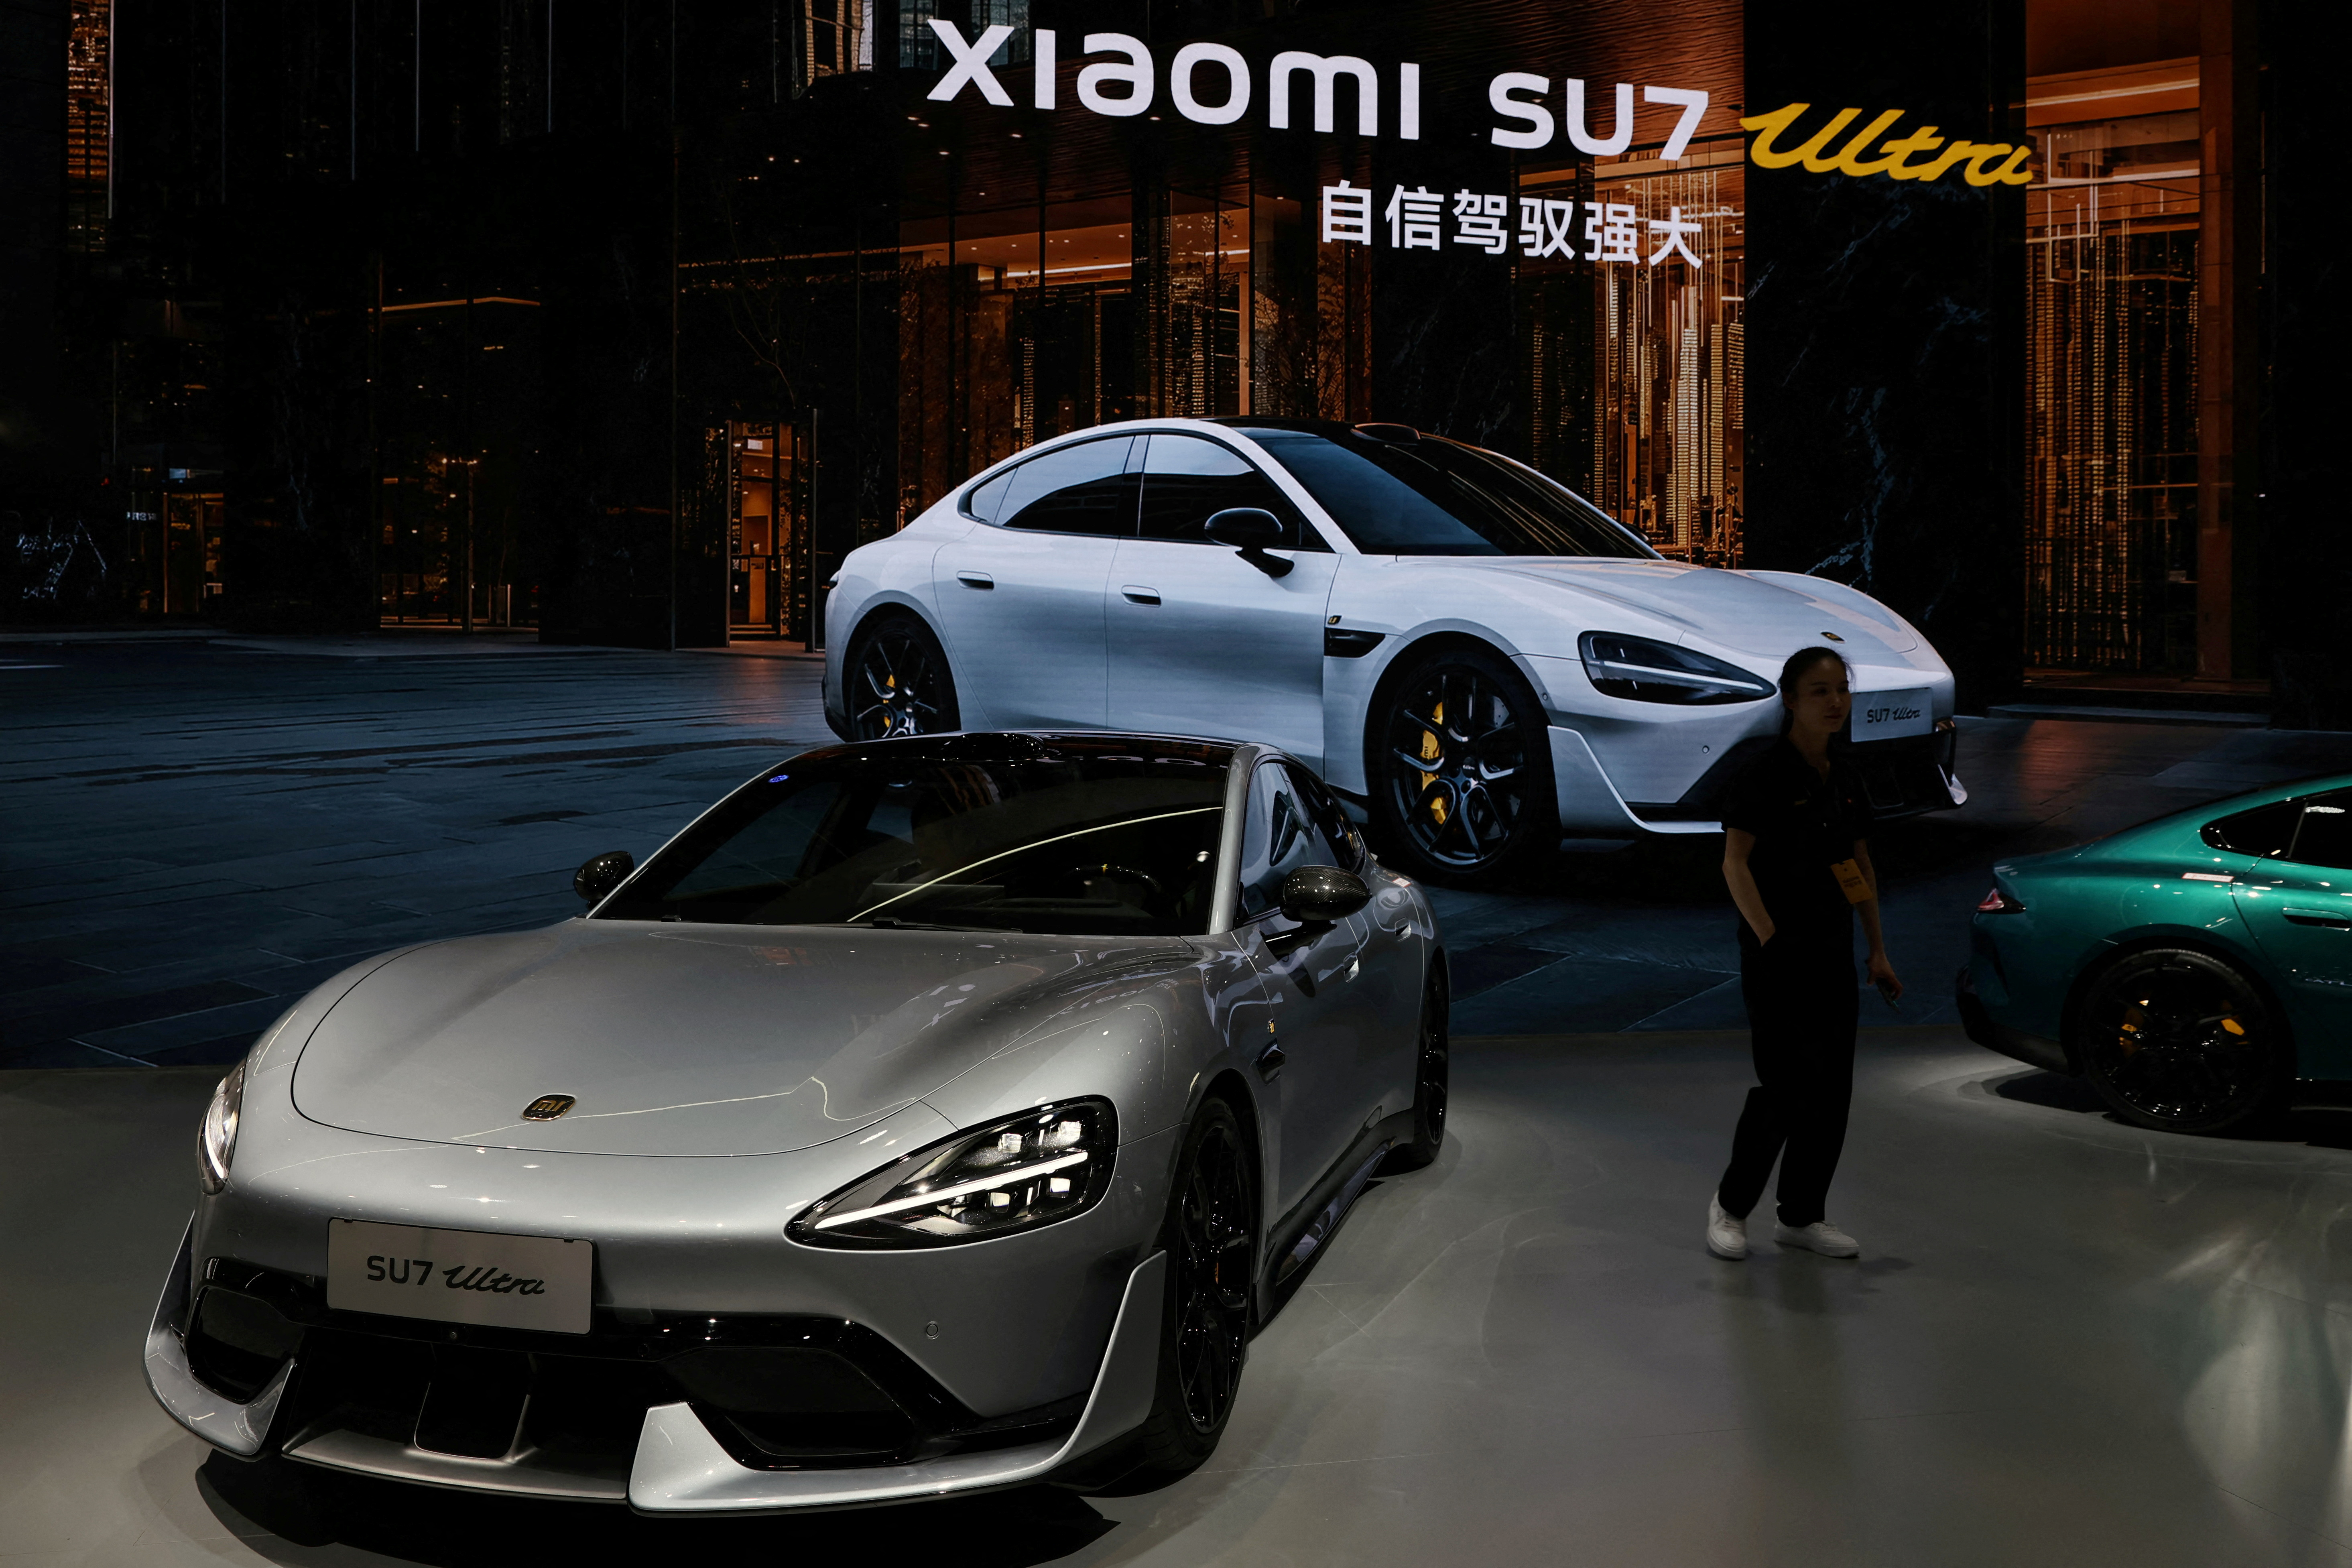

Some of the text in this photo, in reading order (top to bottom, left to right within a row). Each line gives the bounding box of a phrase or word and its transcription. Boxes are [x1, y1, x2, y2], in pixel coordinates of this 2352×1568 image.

[1489, 72, 1709, 161] SU7
[1739, 103, 2033, 186] Ultra
[1322, 179, 1703, 269] 自信驾驭强大
[1867, 707, 1920, 723] SU7 Ultra
[367, 1255, 545, 1295] SU7 Ultra
